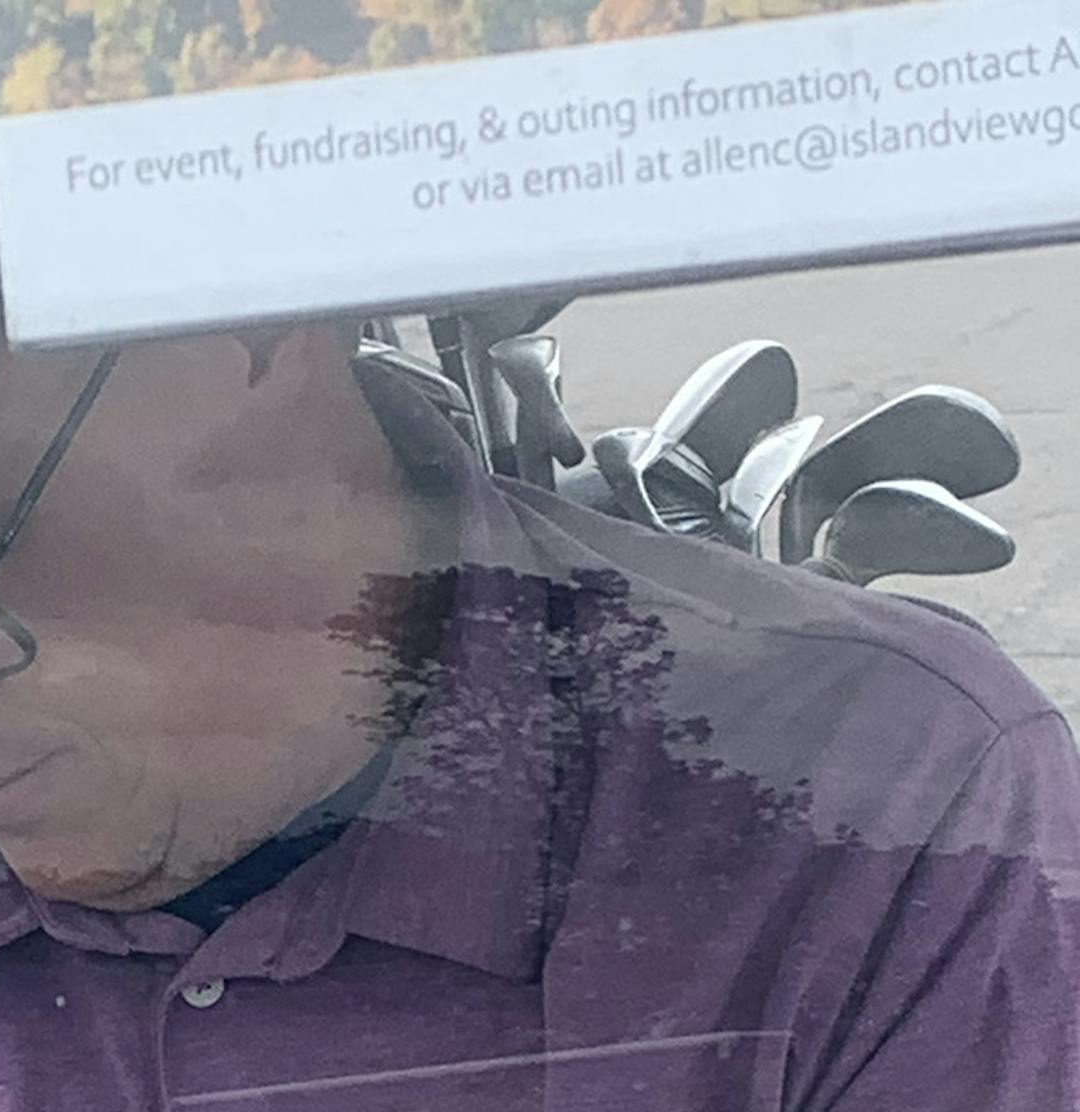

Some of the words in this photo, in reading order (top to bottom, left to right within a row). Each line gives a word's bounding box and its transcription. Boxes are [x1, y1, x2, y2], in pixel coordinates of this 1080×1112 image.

[66, 155, 124, 192] For
[134, 142, 243, 186] event,
[254, 116, 467, 170] fundraising,
[478, 105, 507, 141] &
[519, 98, 637, 140] outing
[647, 70, 882, 123] information,
[894, 43, 1040, 91] contact
[413, 181, 447, 211] or
[460, 170, 512, 203] via
[523, 156, 624, 198] email
[635, 151, 674, 184] at
